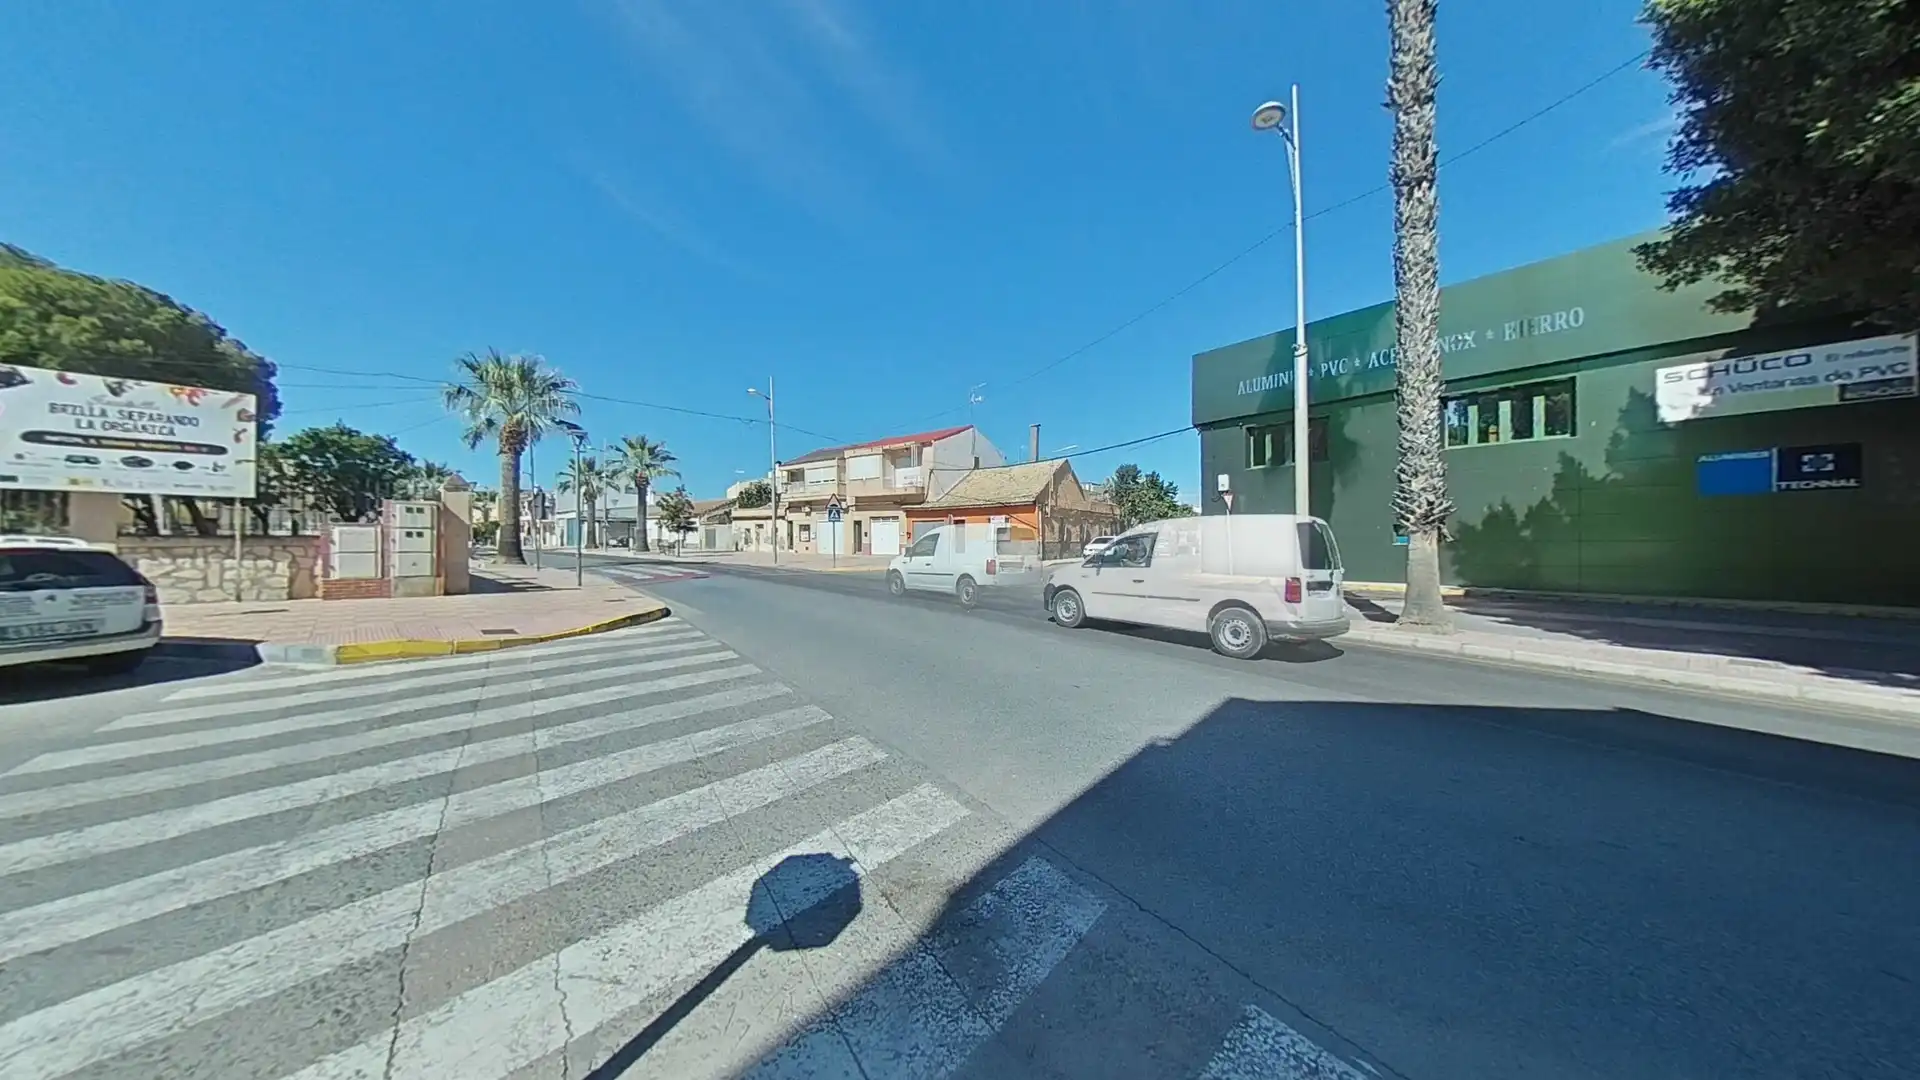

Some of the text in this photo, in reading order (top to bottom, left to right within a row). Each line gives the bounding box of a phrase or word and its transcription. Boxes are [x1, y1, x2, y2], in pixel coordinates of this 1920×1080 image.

[1237, 370, 1296, 396] ALUMINI
[1320, 358, 1348, 378] PVC
[1368, 346, 1399, 369] ACE
[1434, 330, 1477, 354] NOX
[1663, 352, 1813, 384] SCHÜCO
[1858, 361, 1910, 379] PVC
[75, 418, 96, 430] LA
[117, 409, 200, 427] SEPARANDO
